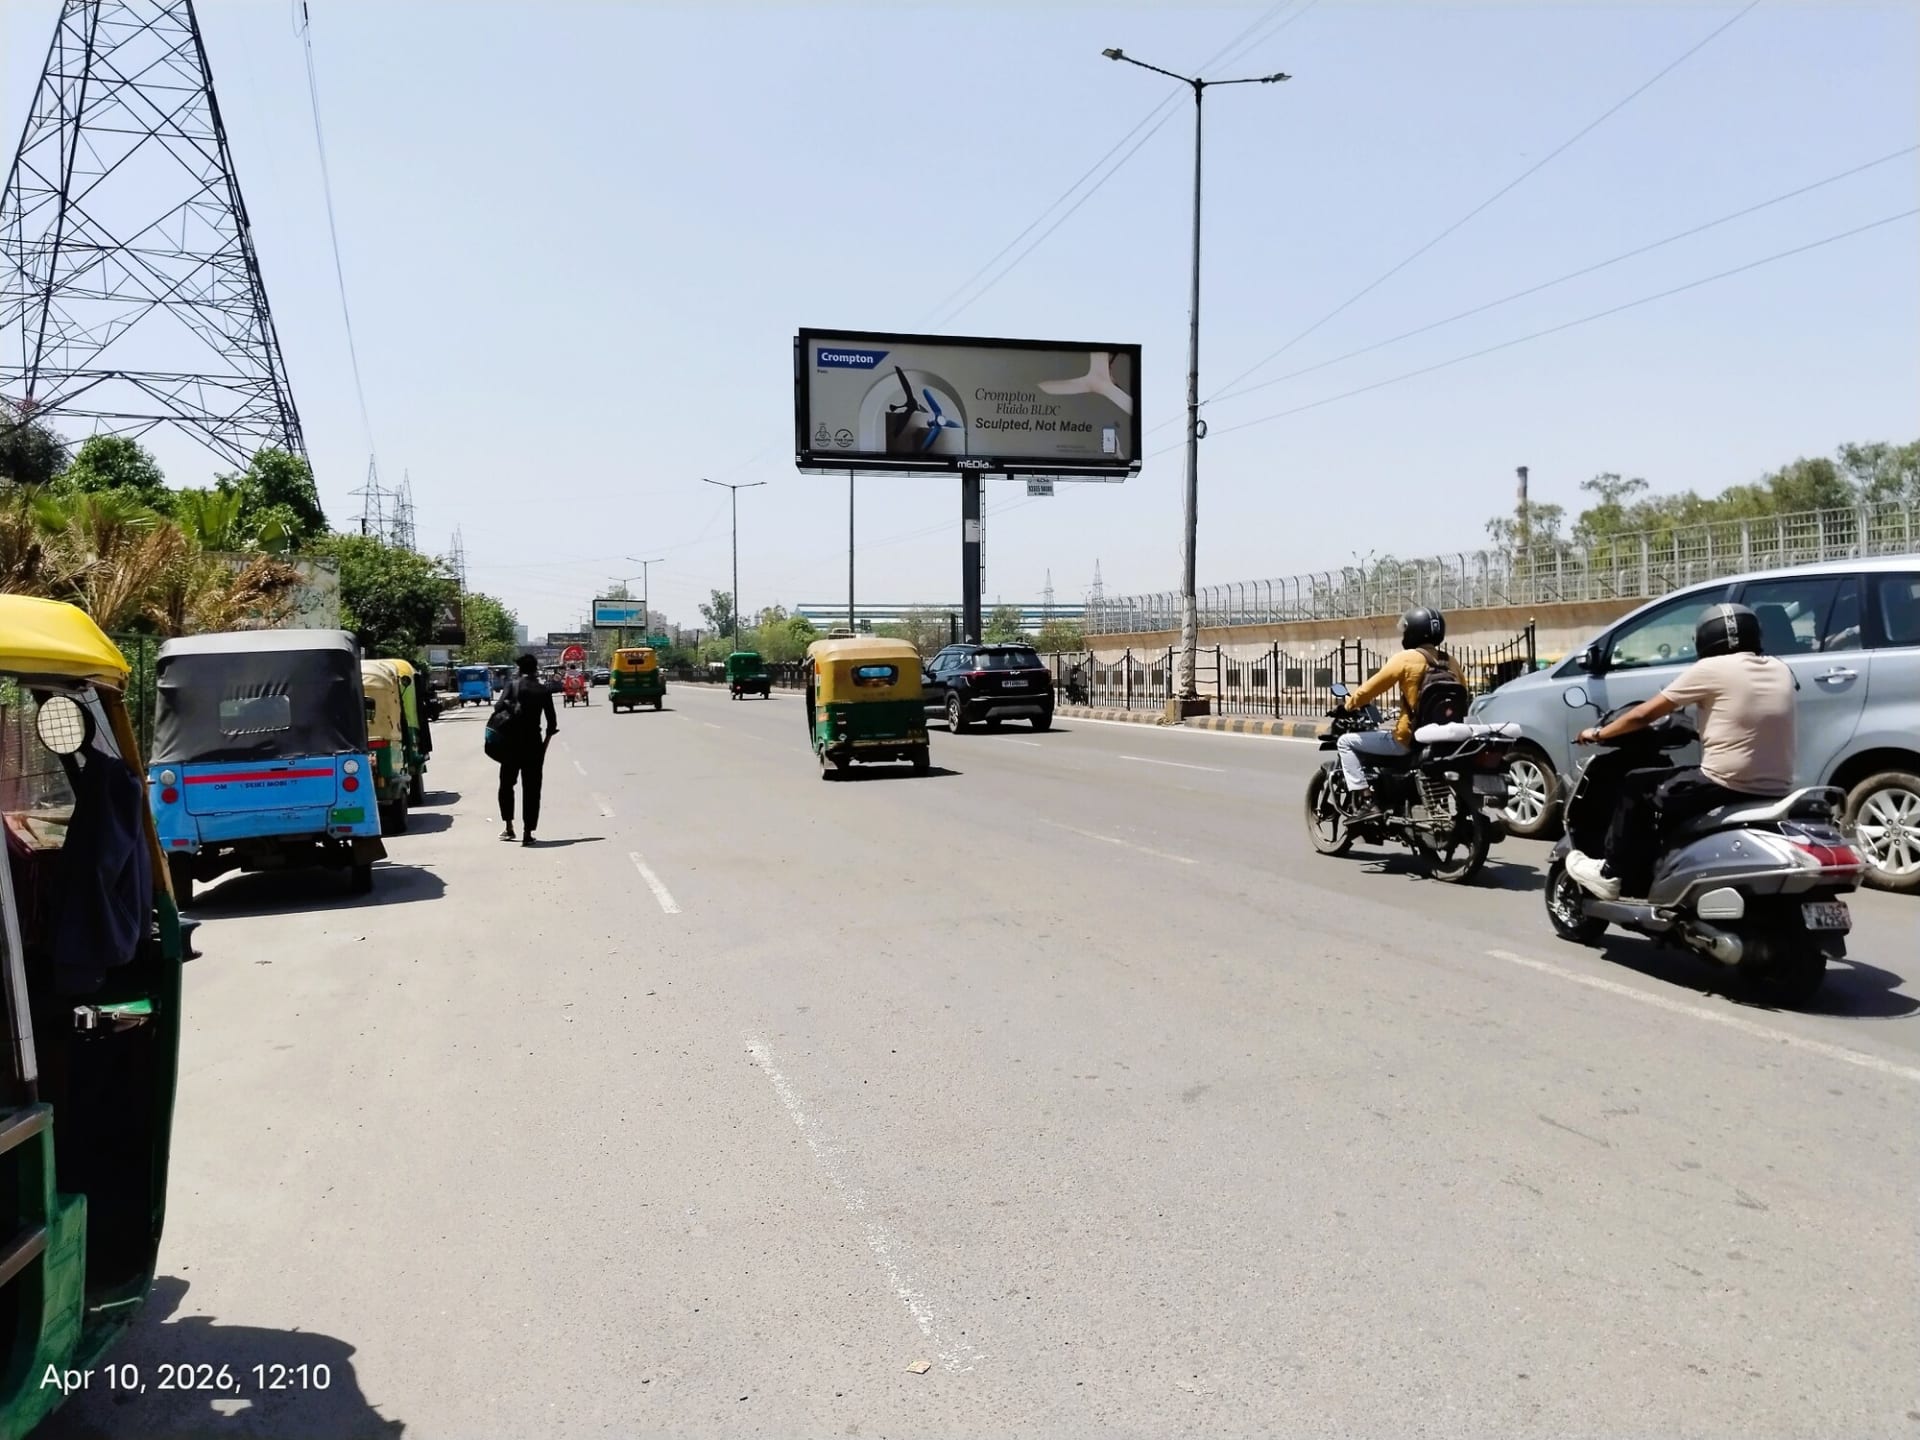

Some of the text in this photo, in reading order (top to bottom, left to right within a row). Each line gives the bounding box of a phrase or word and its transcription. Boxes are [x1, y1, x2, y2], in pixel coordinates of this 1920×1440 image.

[821, 352, 874, 365] Crompton
[975, 387, 1036, 404] Crompton
[996, 403, 1061, 417] Fluido BLDC
[975, 417, 1093, 433] Sculpted, Not Made
